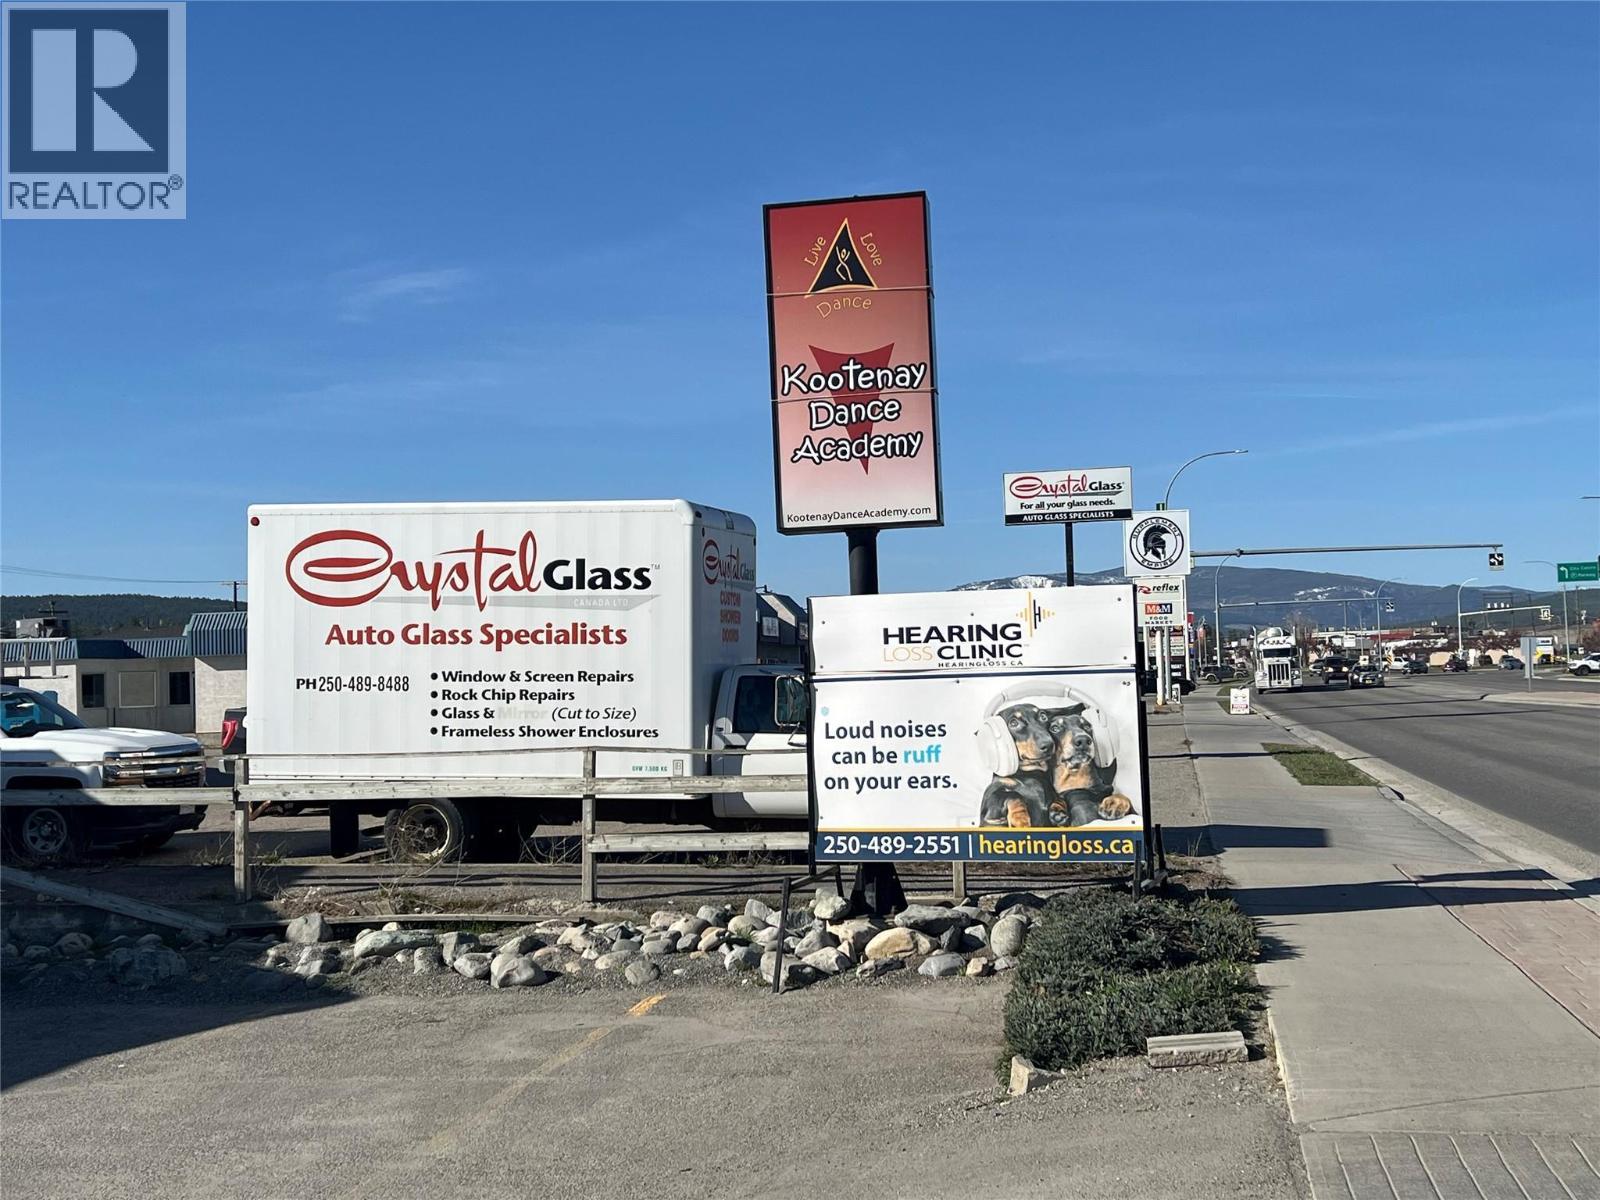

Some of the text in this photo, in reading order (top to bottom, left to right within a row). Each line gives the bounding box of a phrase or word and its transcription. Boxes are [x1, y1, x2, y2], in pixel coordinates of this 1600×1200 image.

[804, 235, 826, 267] Live
[860, 232, 882, 266] Love
[816, 296, 872, 318] Dance
[782, 359, 926, 395] Kootenay
[808, 399, 901, 430] Dance
[792, 431, 922, 463] Academy
[1010, 474, 1122, 499] Crystal Glass
[787, 505, 931, 523] KootenayDanceAcademy.com
[1021, 498, 1115, 511] For all your glass needs.
[1023, 514, 1043, 522] AUTO
[1069, 511, 1114, 520] SPECIALISTS
[286, 529, 541, 612] Crystal
[543, 558, 652, 590] Glass
[1152, 583, 1179, 592] reflex
[574, 599, 610, 607] CANADA
[1146, 604, 1172, 614] M&M
[325, 622, 627, 651] Auto Glass Specialists
[883, 623, 1022, 645] HEARING
[884, 644, 1023, 662] LOSS CLINIC
[296, 675, 410, 692] PH 250-489-8488
[441, 670, 634, 686] Window & Screen Repairs
[442, 688, 575, 704] Rock Chip Repairs
[442, 707, 637, 722] Glass & Mirror (Cut to Size)
[441, 725, 659, 738] Frameless Shower Enclosures
[824, 720, 947, 740] Loud noises
[832, 744, 942, 764] can be ruff
[824, 773, 958, 794] on your ears.
[823, 834, 1134, 859] 250-489-2551 hearingloss.ca
